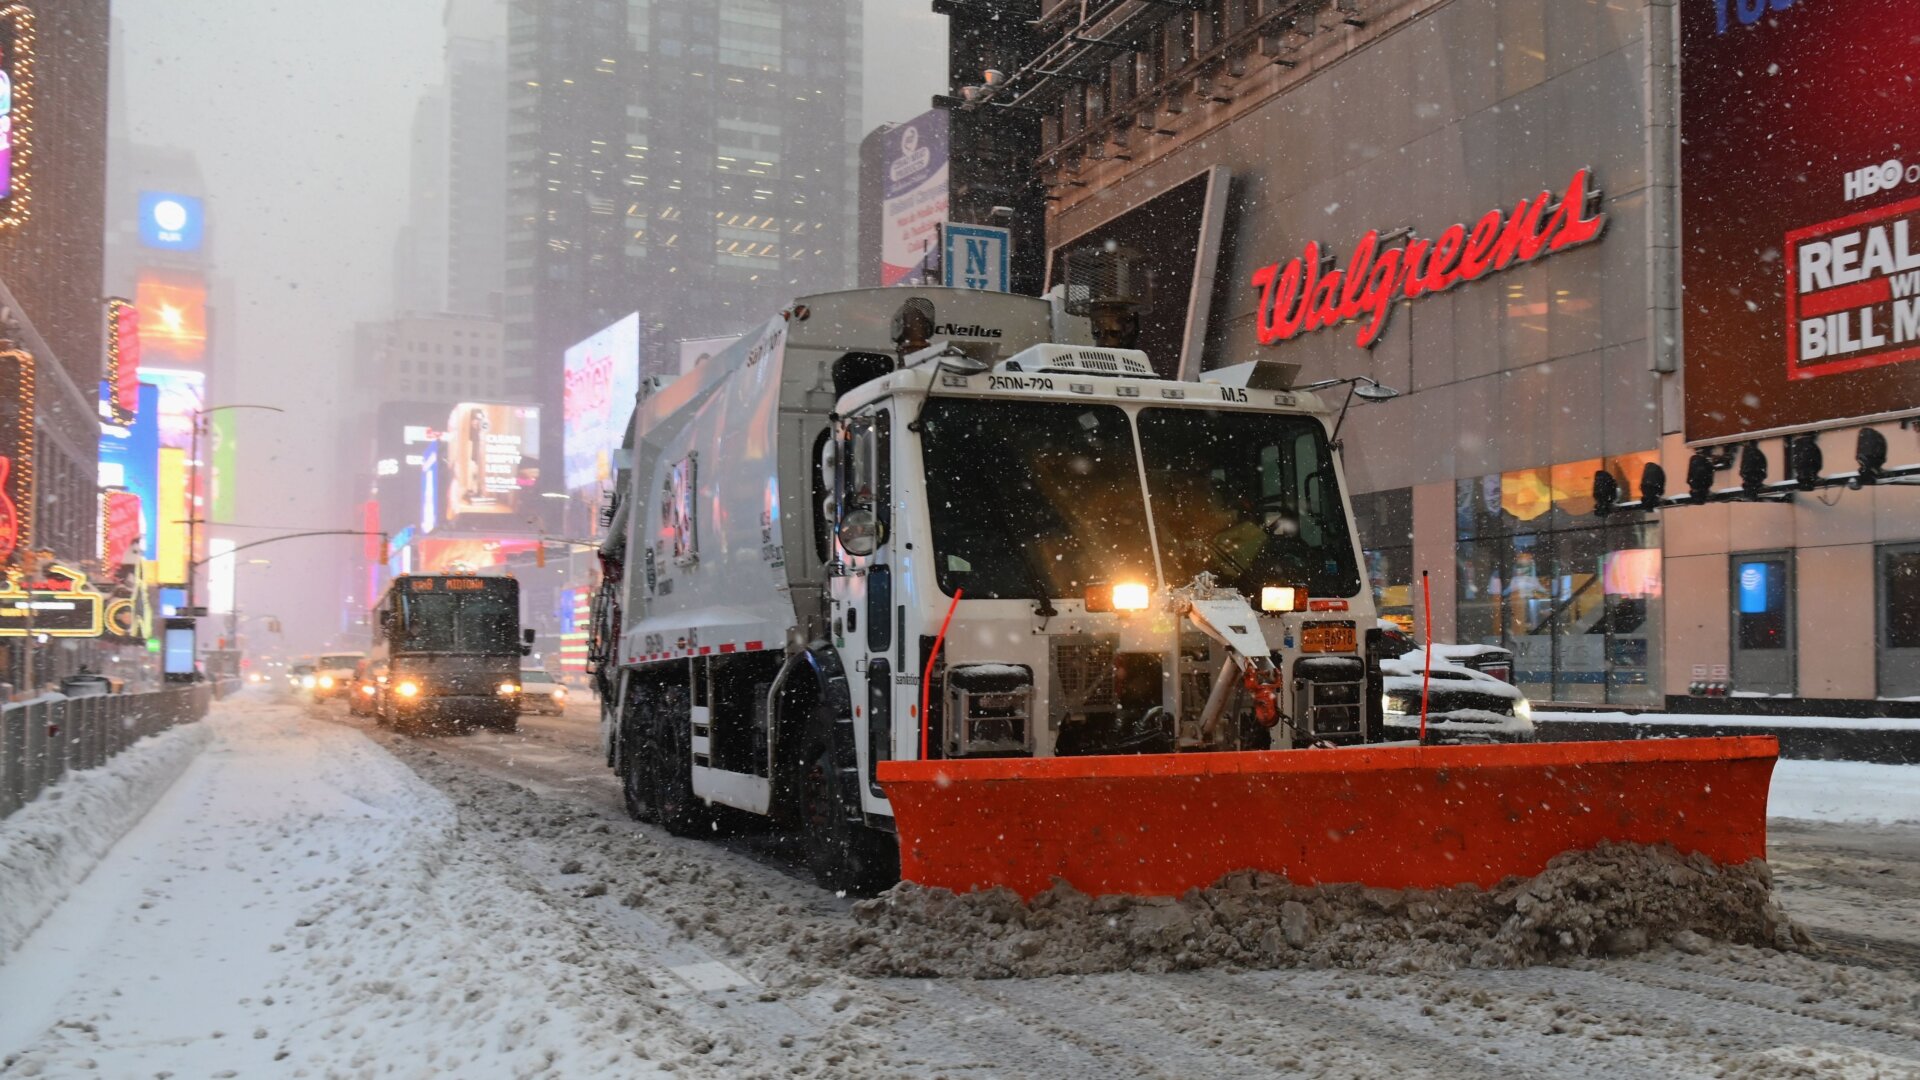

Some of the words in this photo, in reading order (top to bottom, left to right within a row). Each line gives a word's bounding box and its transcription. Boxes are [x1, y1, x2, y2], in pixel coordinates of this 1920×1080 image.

[1844, 159, 1904, 202] HBO
[1252, 166, 1606, 348] Walgreens
[1799, 219, 1920, 293] REAL
[934, 322, 1003, 338] cNeilus
[1801, 306, 1886, 361] BILL
